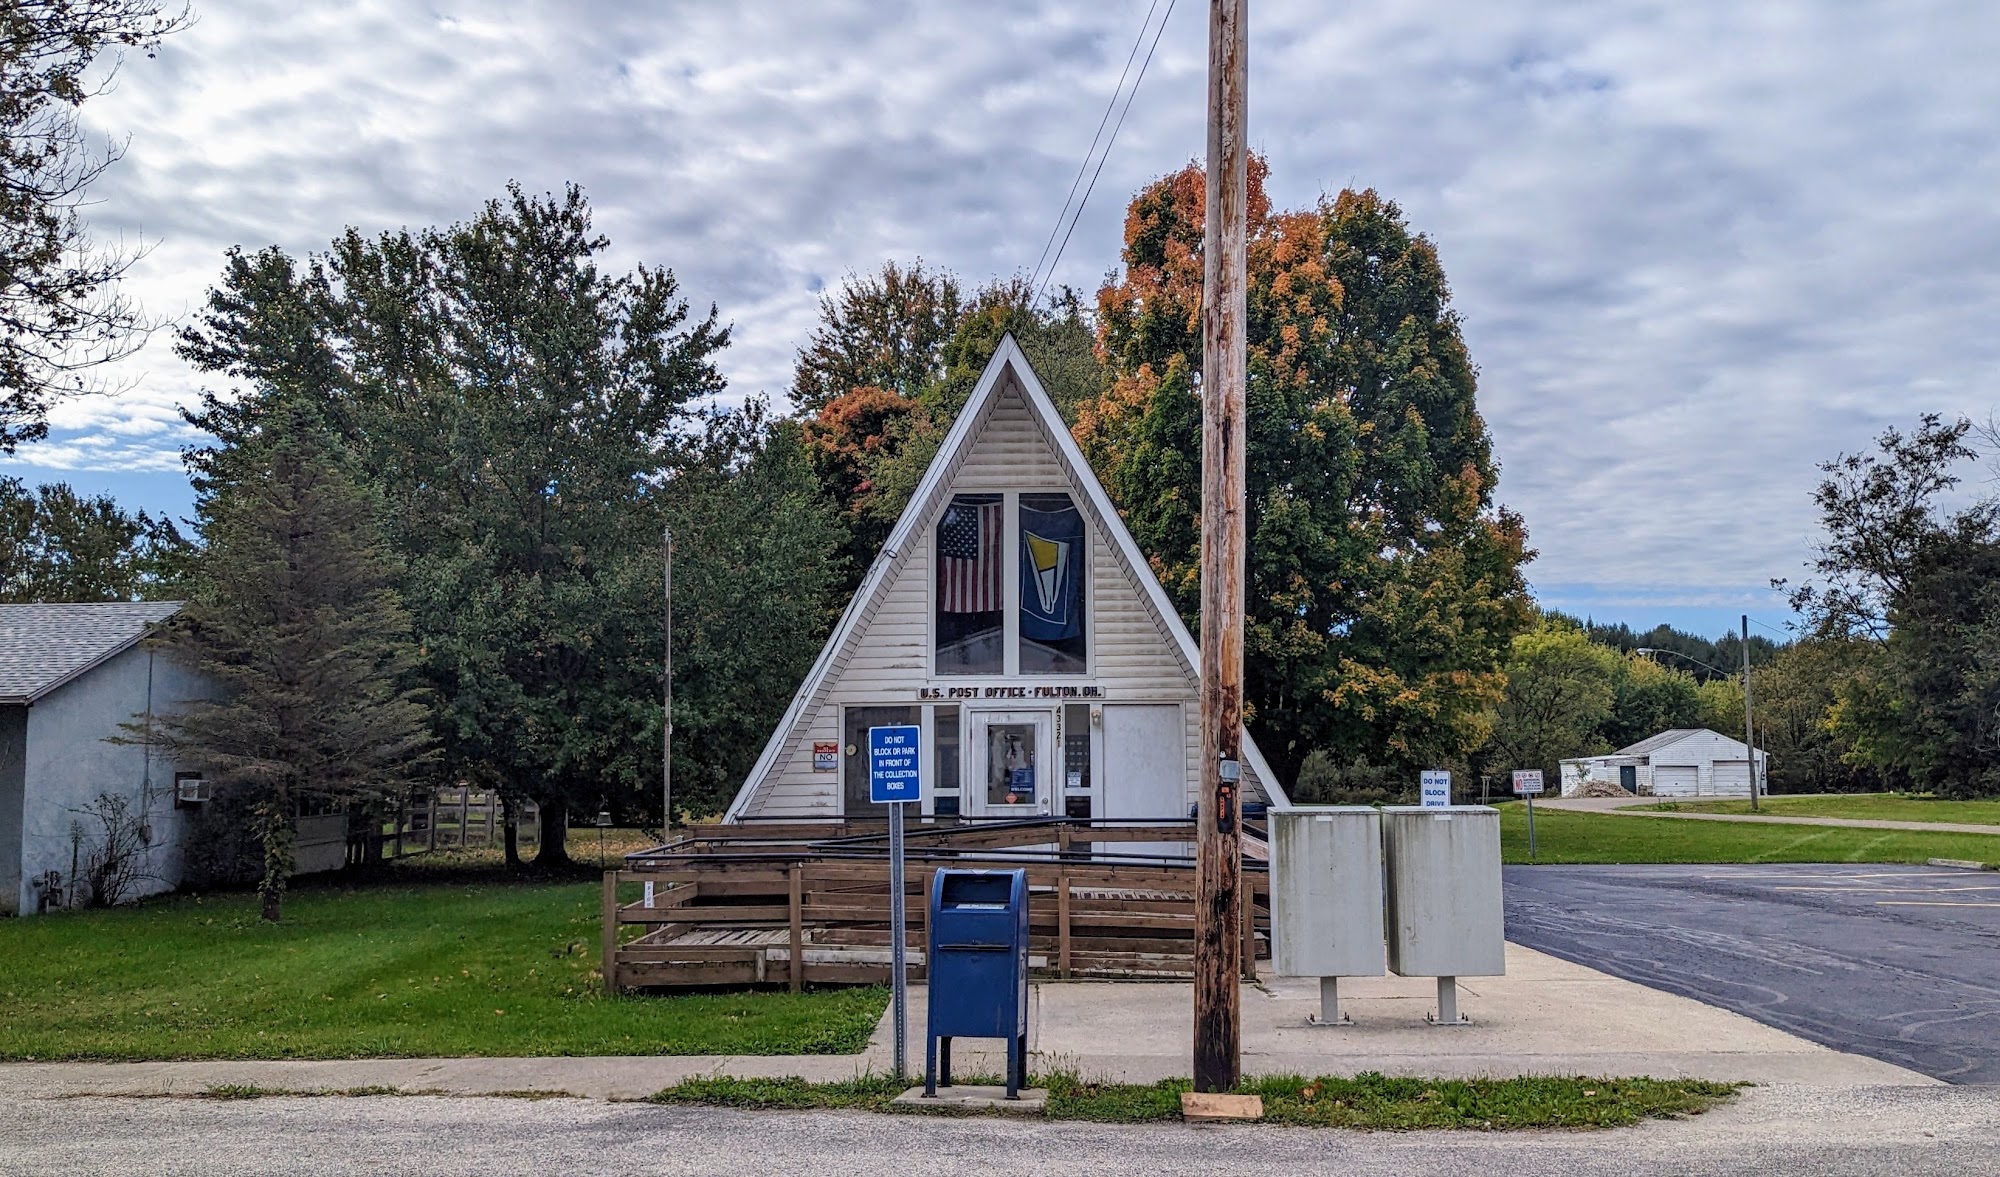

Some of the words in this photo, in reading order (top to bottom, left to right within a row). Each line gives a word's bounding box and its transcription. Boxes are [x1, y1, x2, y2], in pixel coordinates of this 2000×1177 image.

[920, 688, 944, 698] U.S.
[948, 687, 979, 698] POST
[985, 686, 1026, 698] OFFICE
[887, 782, 904, 790] BOXES
